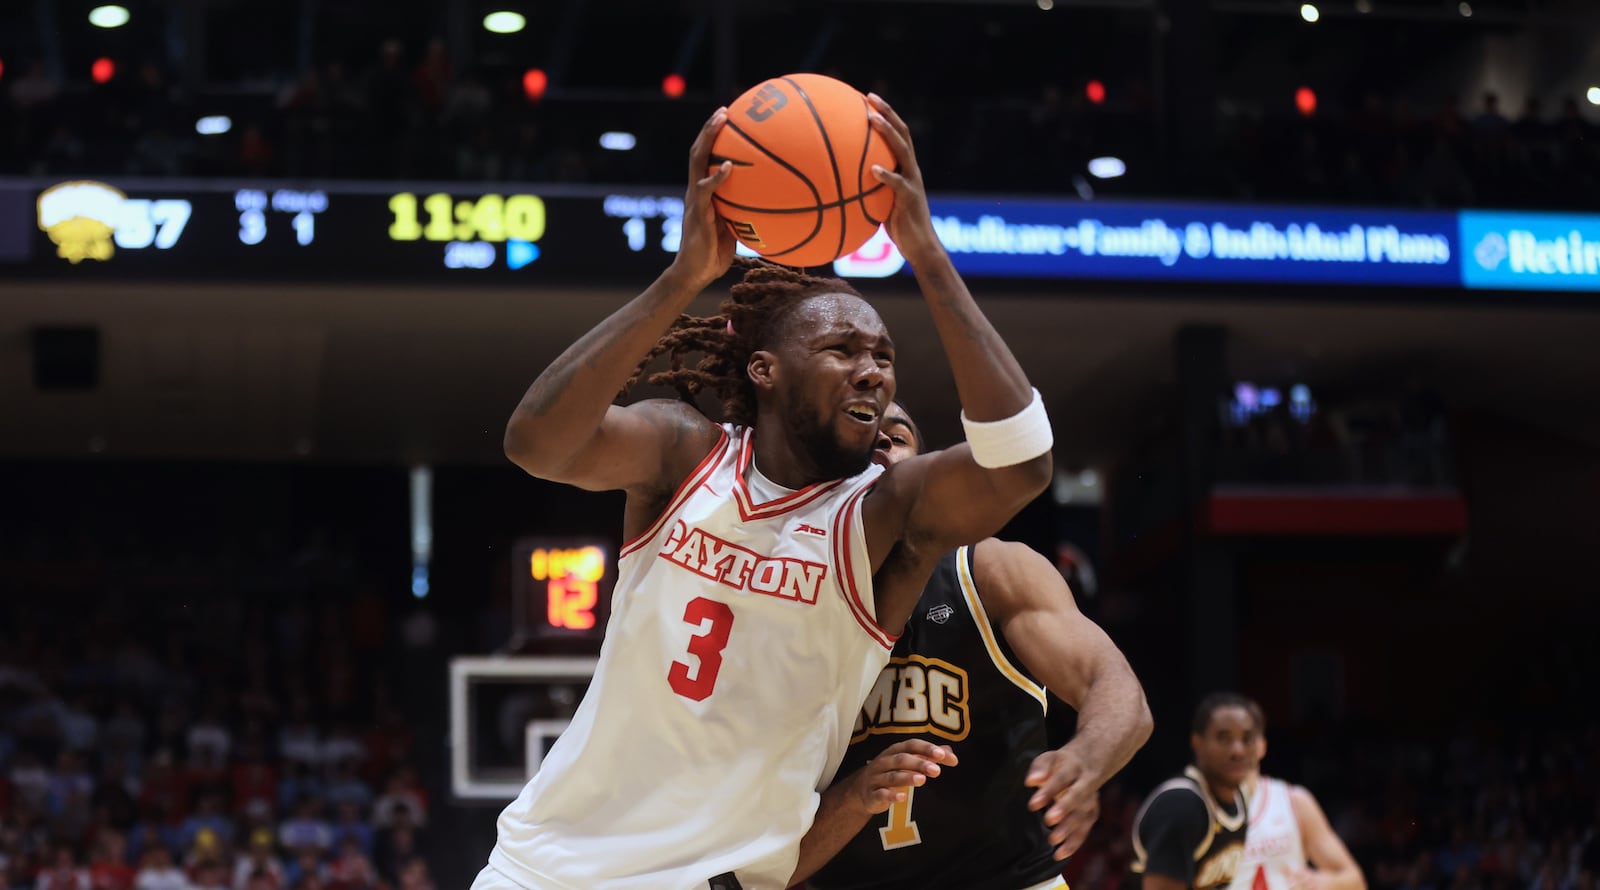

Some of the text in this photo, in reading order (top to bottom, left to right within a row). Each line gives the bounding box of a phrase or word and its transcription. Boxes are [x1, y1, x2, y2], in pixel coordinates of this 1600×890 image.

[238, 208, 266, 245] 3
[292, 210, 315, 246] 1
[388, 193, 546, 242] 11:40
[622, 217, 646, 252] 1
[1077, 218, 1184, 266] Family
[1211, 221, 1366, 263] Individual
[1366, 224, 1451, 265] Plans
[547, 578, 598, 630] 12
[667, 596, 735, 702] 3
[853, 656, 969, 739] MBC
[879, 784, 922, 851] 1
